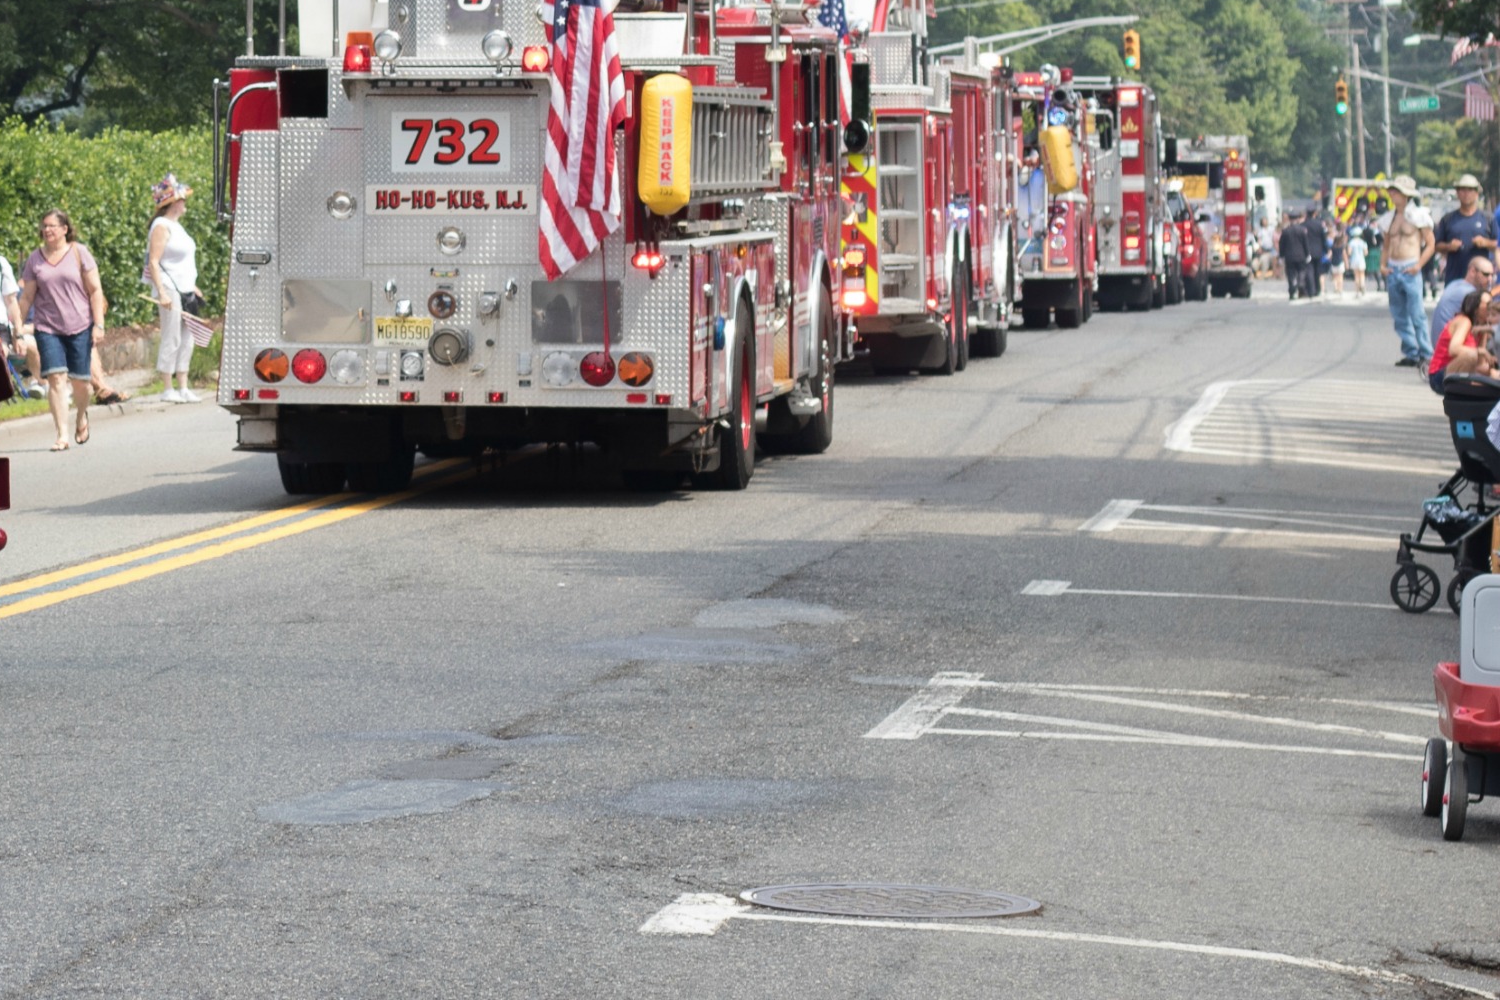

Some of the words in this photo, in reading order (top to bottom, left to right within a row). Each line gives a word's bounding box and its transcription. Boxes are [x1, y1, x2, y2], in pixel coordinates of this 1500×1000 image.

[662, 99, 672, 137] KEEP
[401, 118, 501, 165] 732
[661, 142, 672, 181] BACK
[376, 189, 490, 210] HO-HO-KUS,
[496, 189, 528, 210] N.J.
